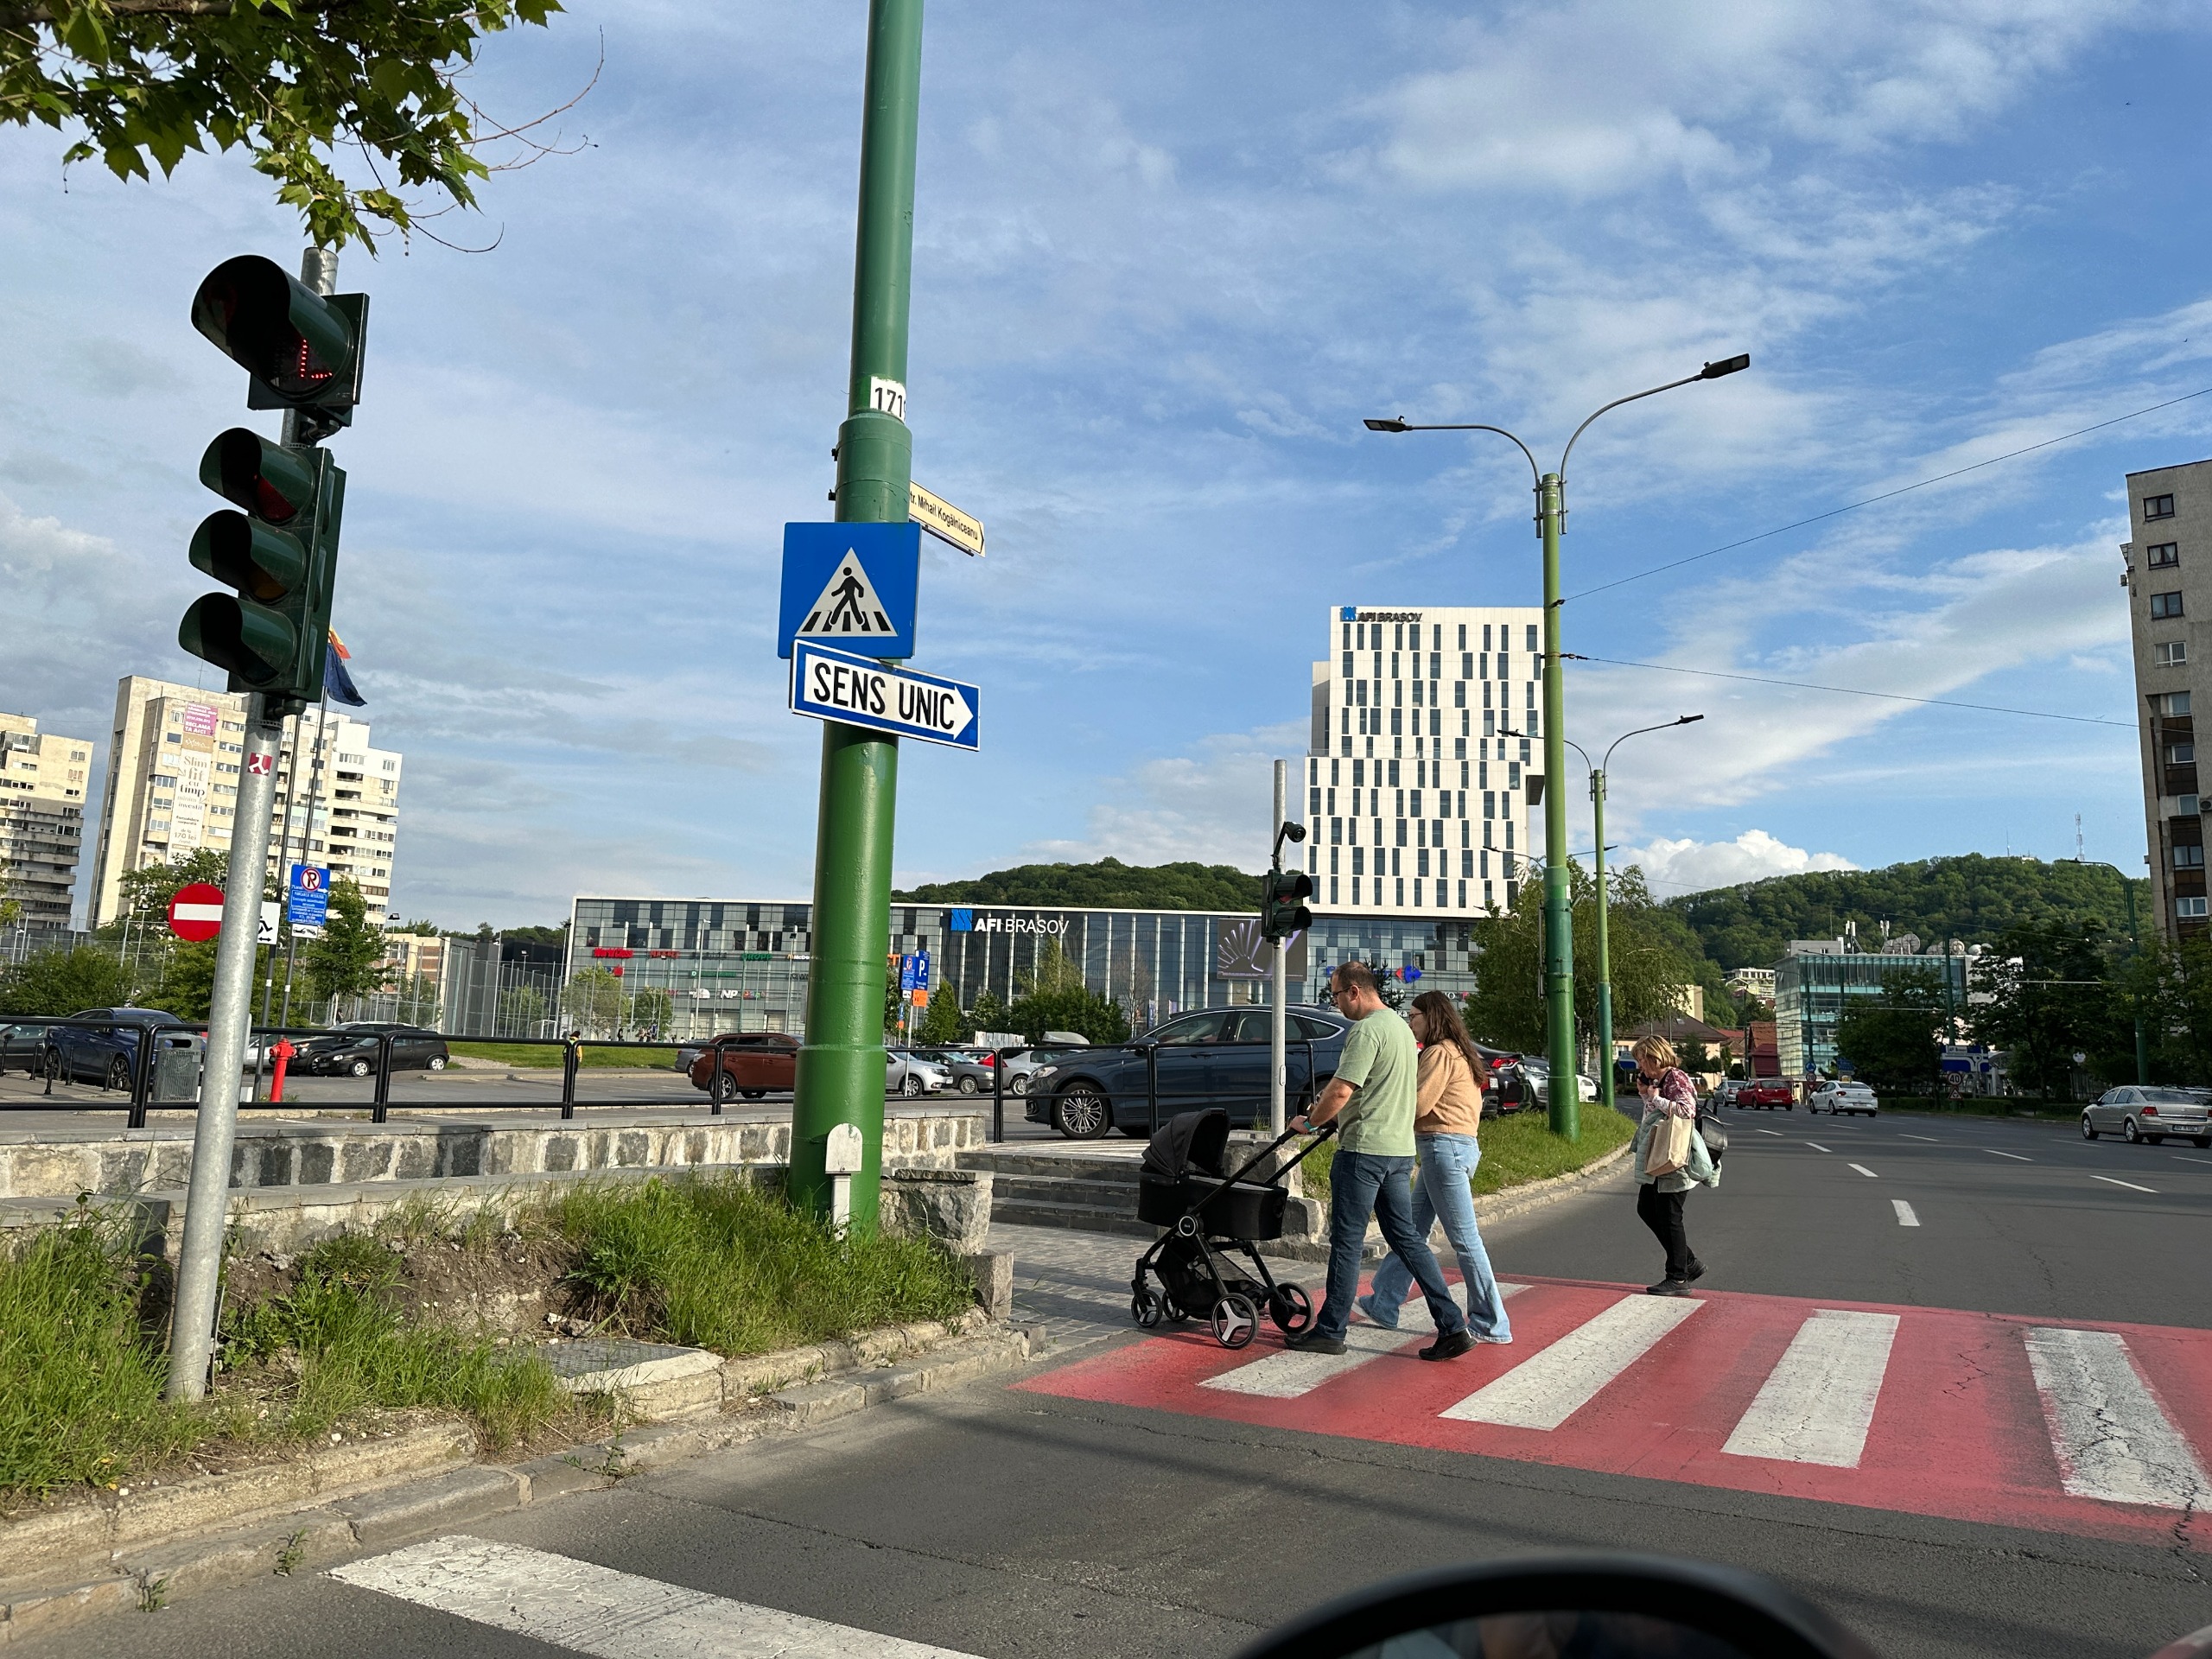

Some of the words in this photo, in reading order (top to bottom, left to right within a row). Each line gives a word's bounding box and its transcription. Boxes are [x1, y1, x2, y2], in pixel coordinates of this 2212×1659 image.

[874, 387, 906, 422] 171
[918, 494, 938, 517] Mihail
[938, 506, 978, 541] Kogălniceanu
[1357, 612, 1376, 622] AFI
[813, 662, 886, 715] SENS
[899, 682, 955, 730] UNIC
[183, 755, 207, 768] Slim
[188, 766, 204, 782] fit
[180, 785, 206, 798] timp
[974, 918, 1002, 932] AFI
[1949, 1074, 1961, 1083] 40
